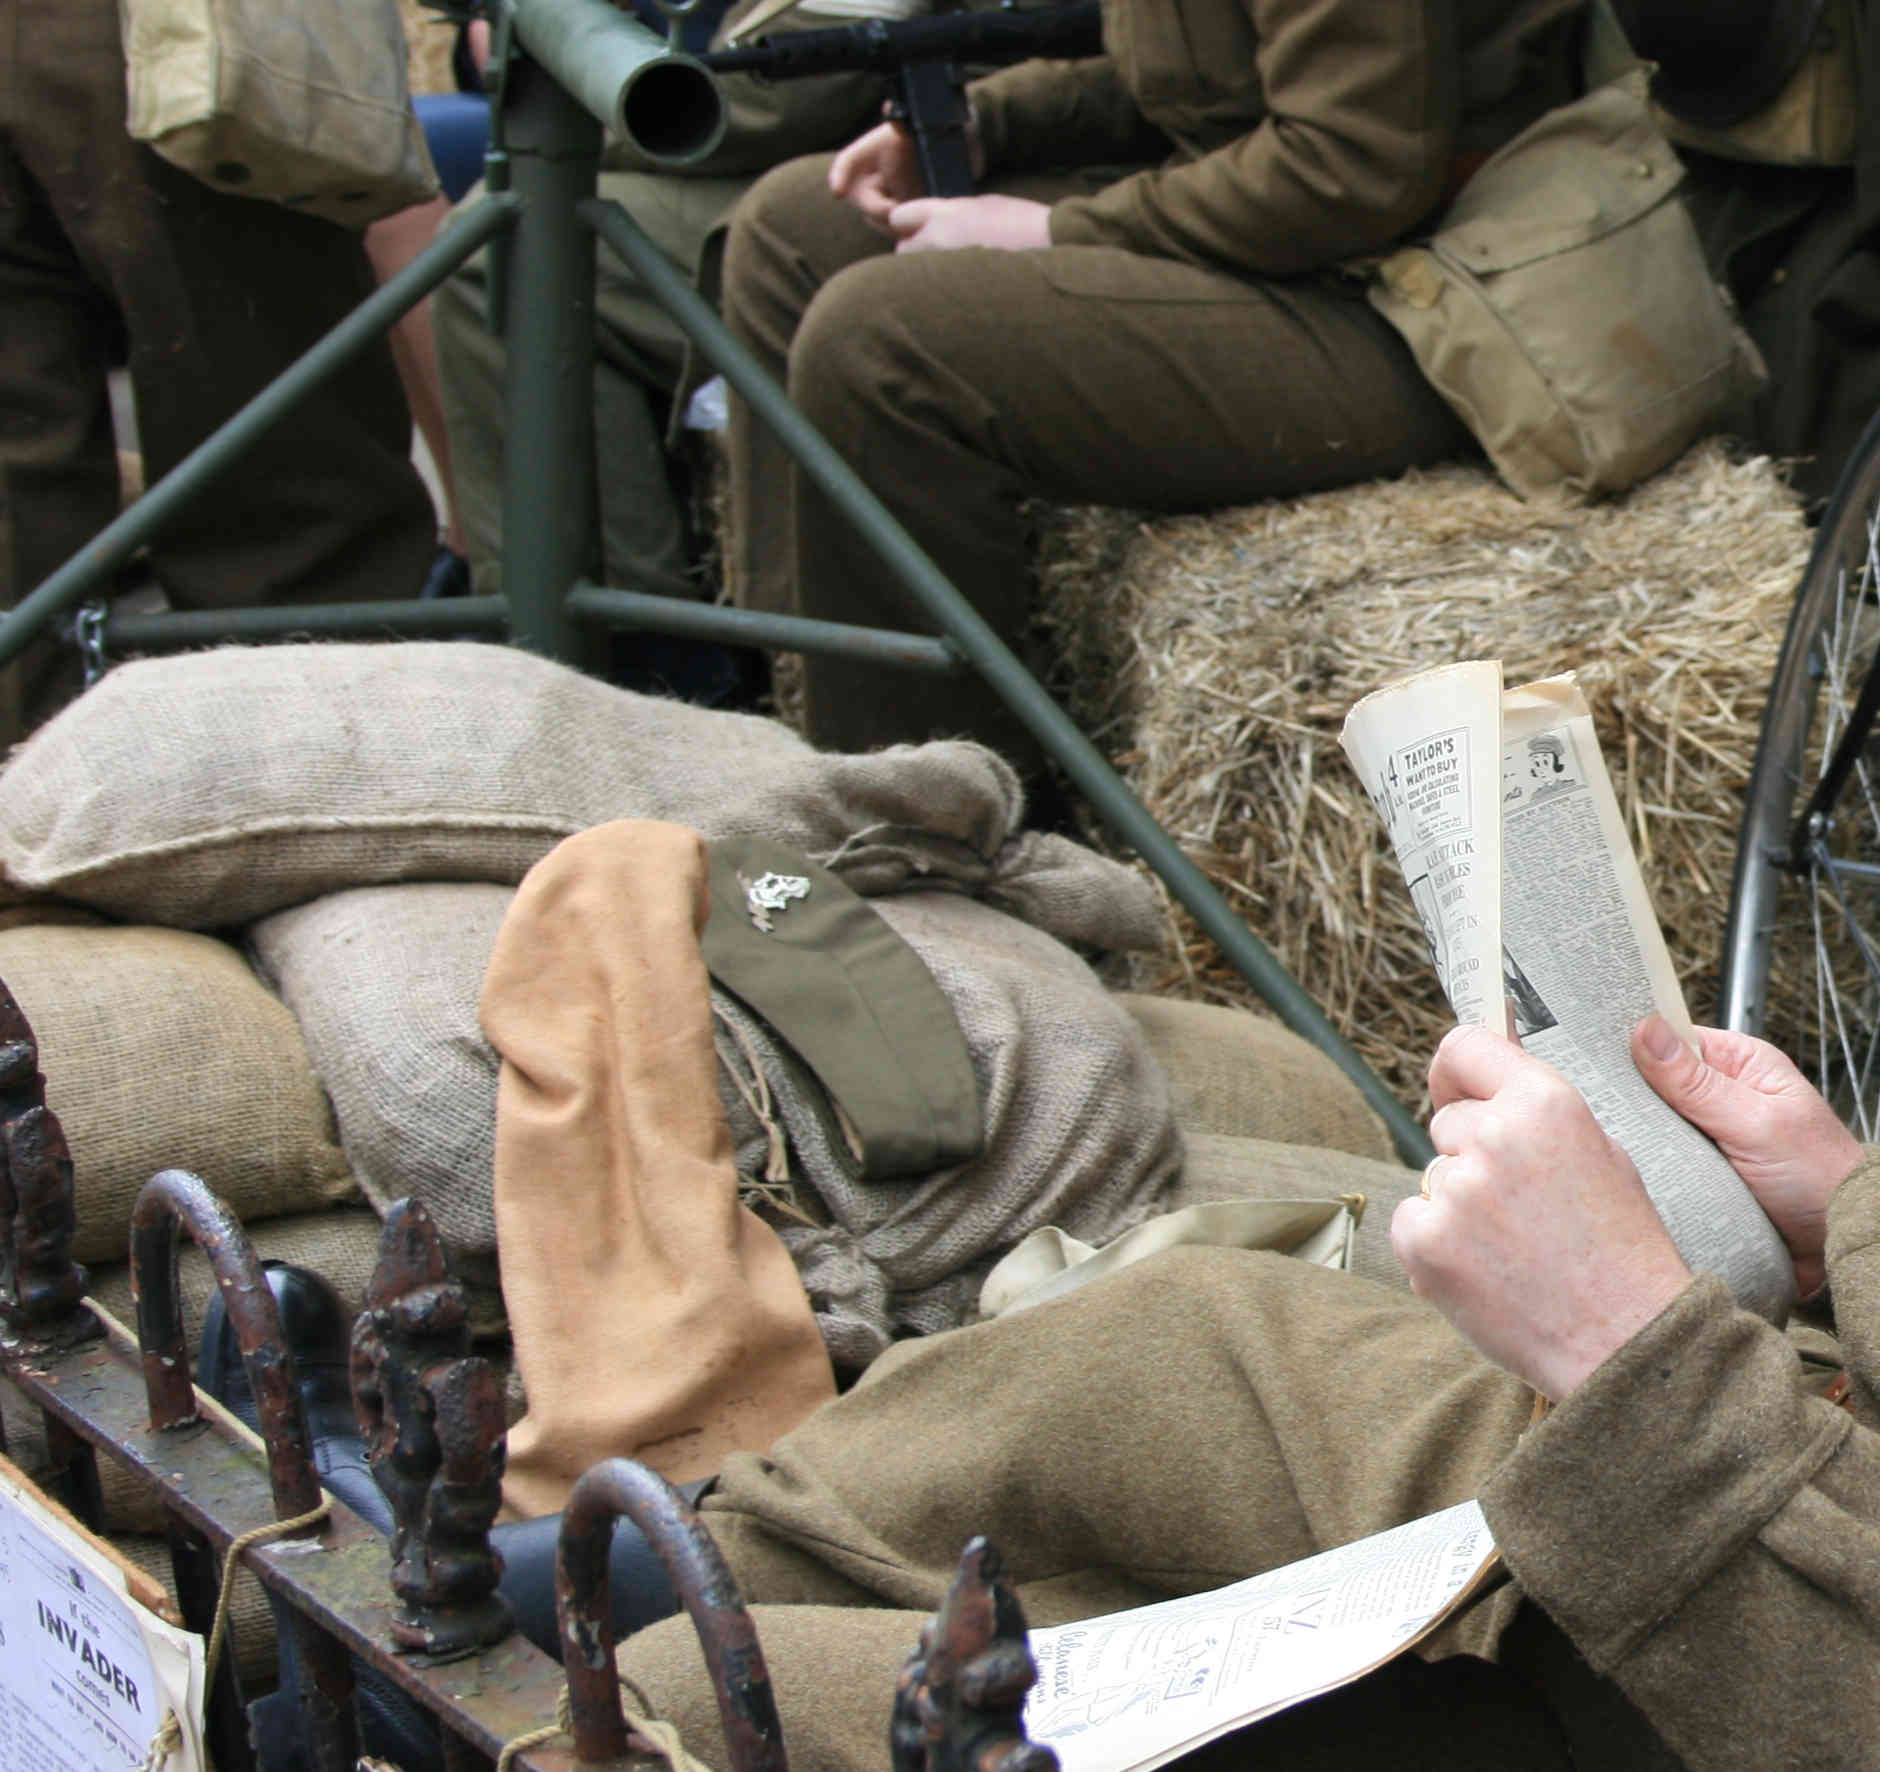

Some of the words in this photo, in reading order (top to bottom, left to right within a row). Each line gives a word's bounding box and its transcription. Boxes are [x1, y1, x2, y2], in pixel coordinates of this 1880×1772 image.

[1404, 737, 1455, 770] TAYLOR'S
[1405, 768, 1426, 786] WANT
[1436, 758, 1458, 774] BUY
[37, 1599, 142, 1715] INVADER
